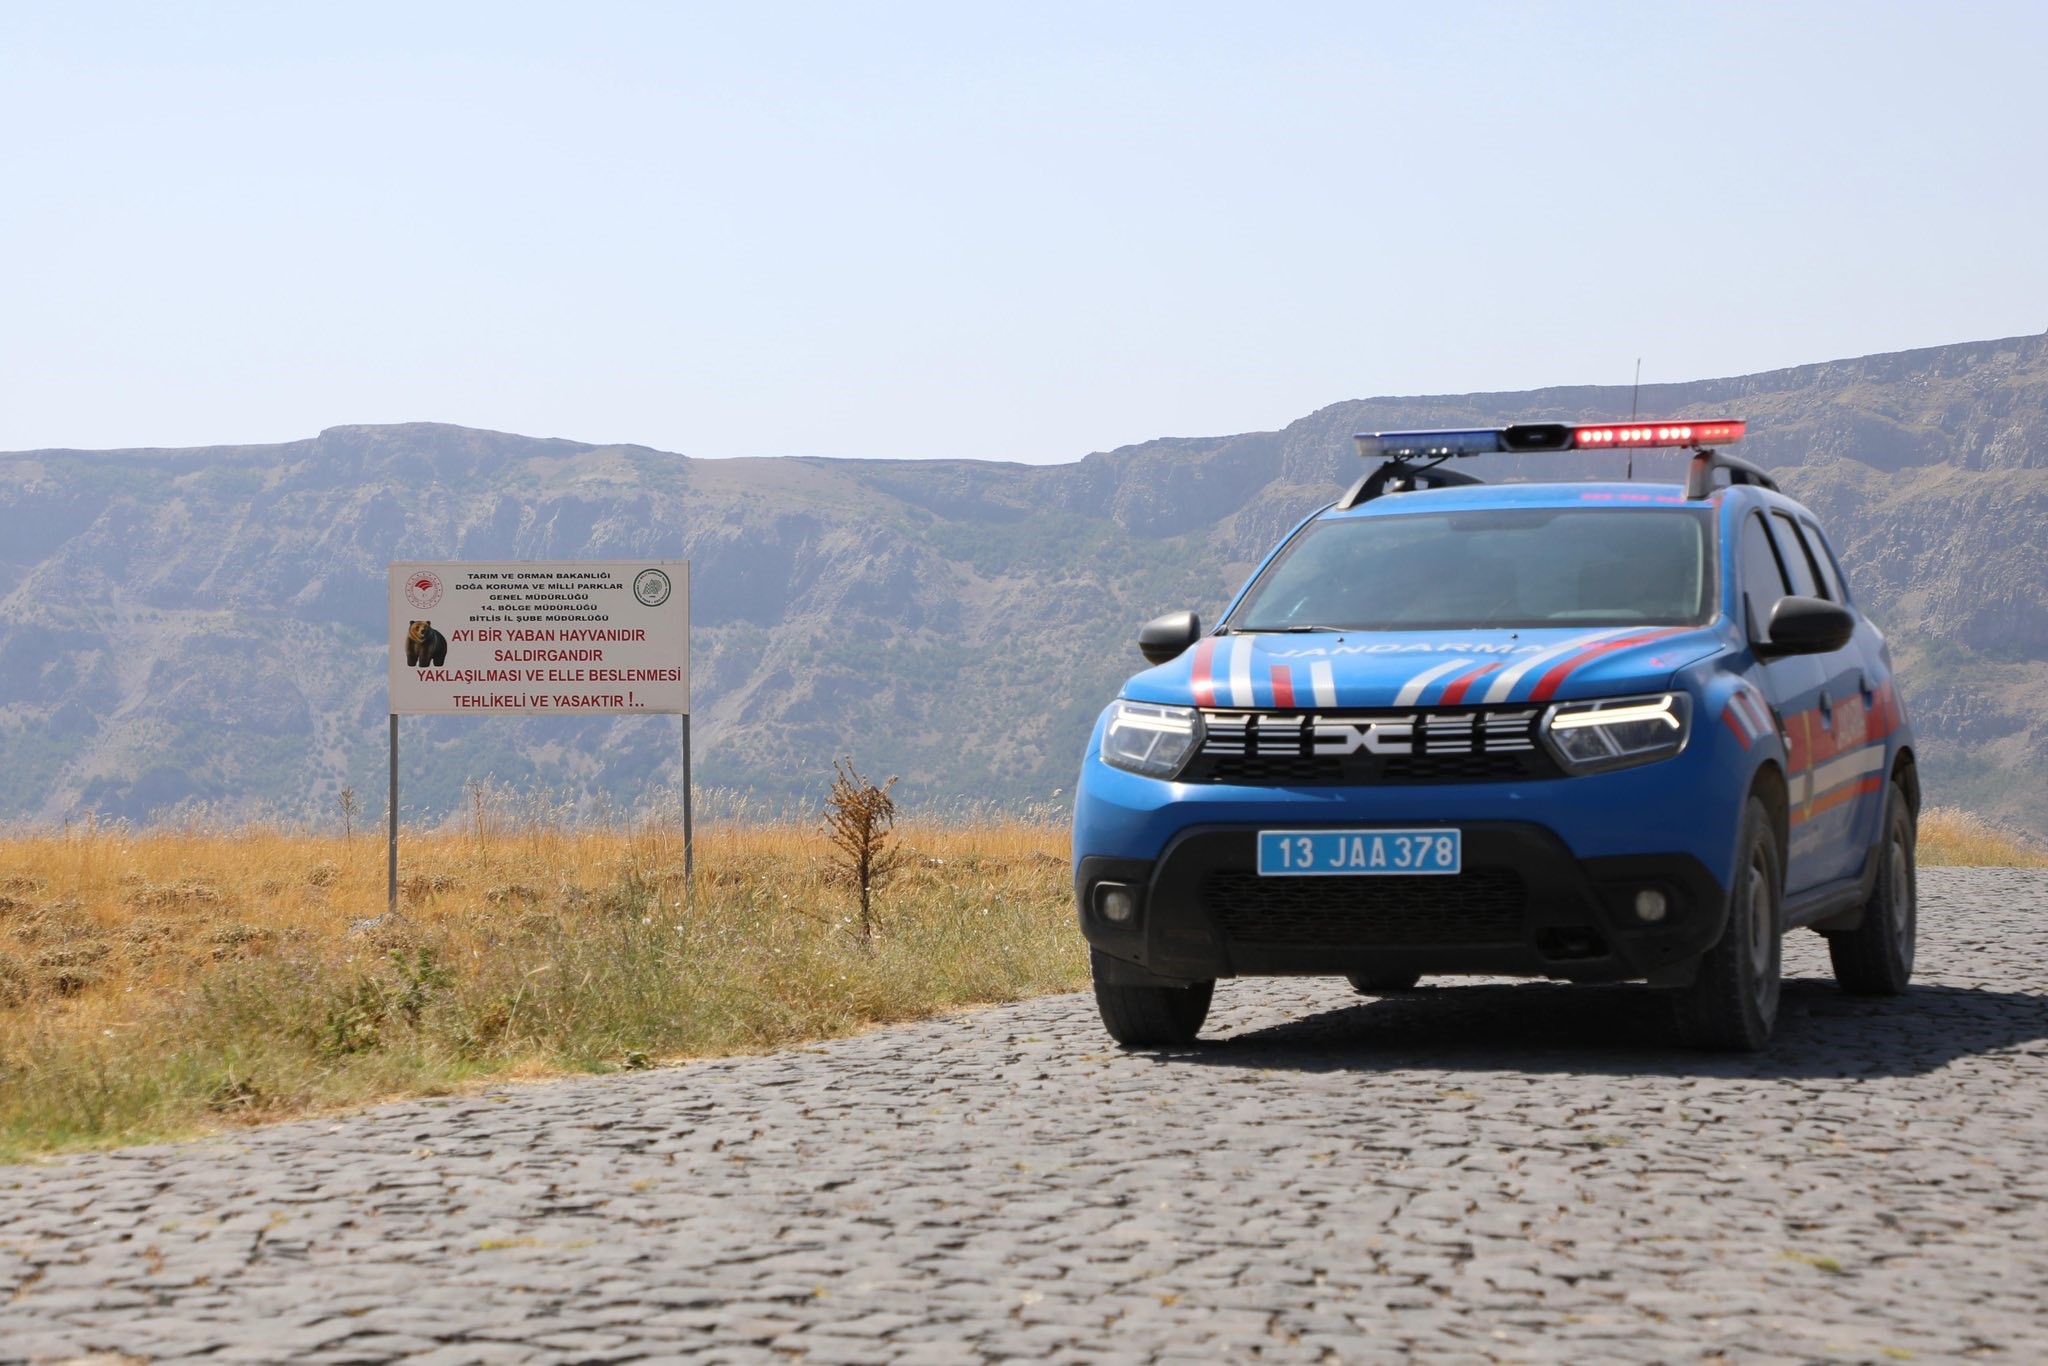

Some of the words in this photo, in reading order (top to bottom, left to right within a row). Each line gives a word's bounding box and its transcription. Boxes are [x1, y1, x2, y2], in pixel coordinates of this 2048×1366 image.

[452, 630, 473, 641] AYI
[479, 627, 502, 641] BİR
[506, 630, 554, 641] YABAN
[560, 629, 645, 641] HAYVANIDIR
[495, 649, 603, 662] SALDIRGANDIR
[1267, 643, 1547, 657] JANDARMA
[417, 669, 521, 684] YAKLAŞILMASI
[525, 670, 544, 681] VE
[549, 670, 584, 681] ELLE
[589, 666, 681, 681] BESLENMESİ
[453, 693, 525, 708] TEHLİKELİ
[530, 695, 549, 708] VE
[553, 695, 624, 708] YASAKTIR
[1280, 837, 1313, 868] 13
[1330, 837, 1386, 867] JAA
[1394, 836, 1453, 867] 378
